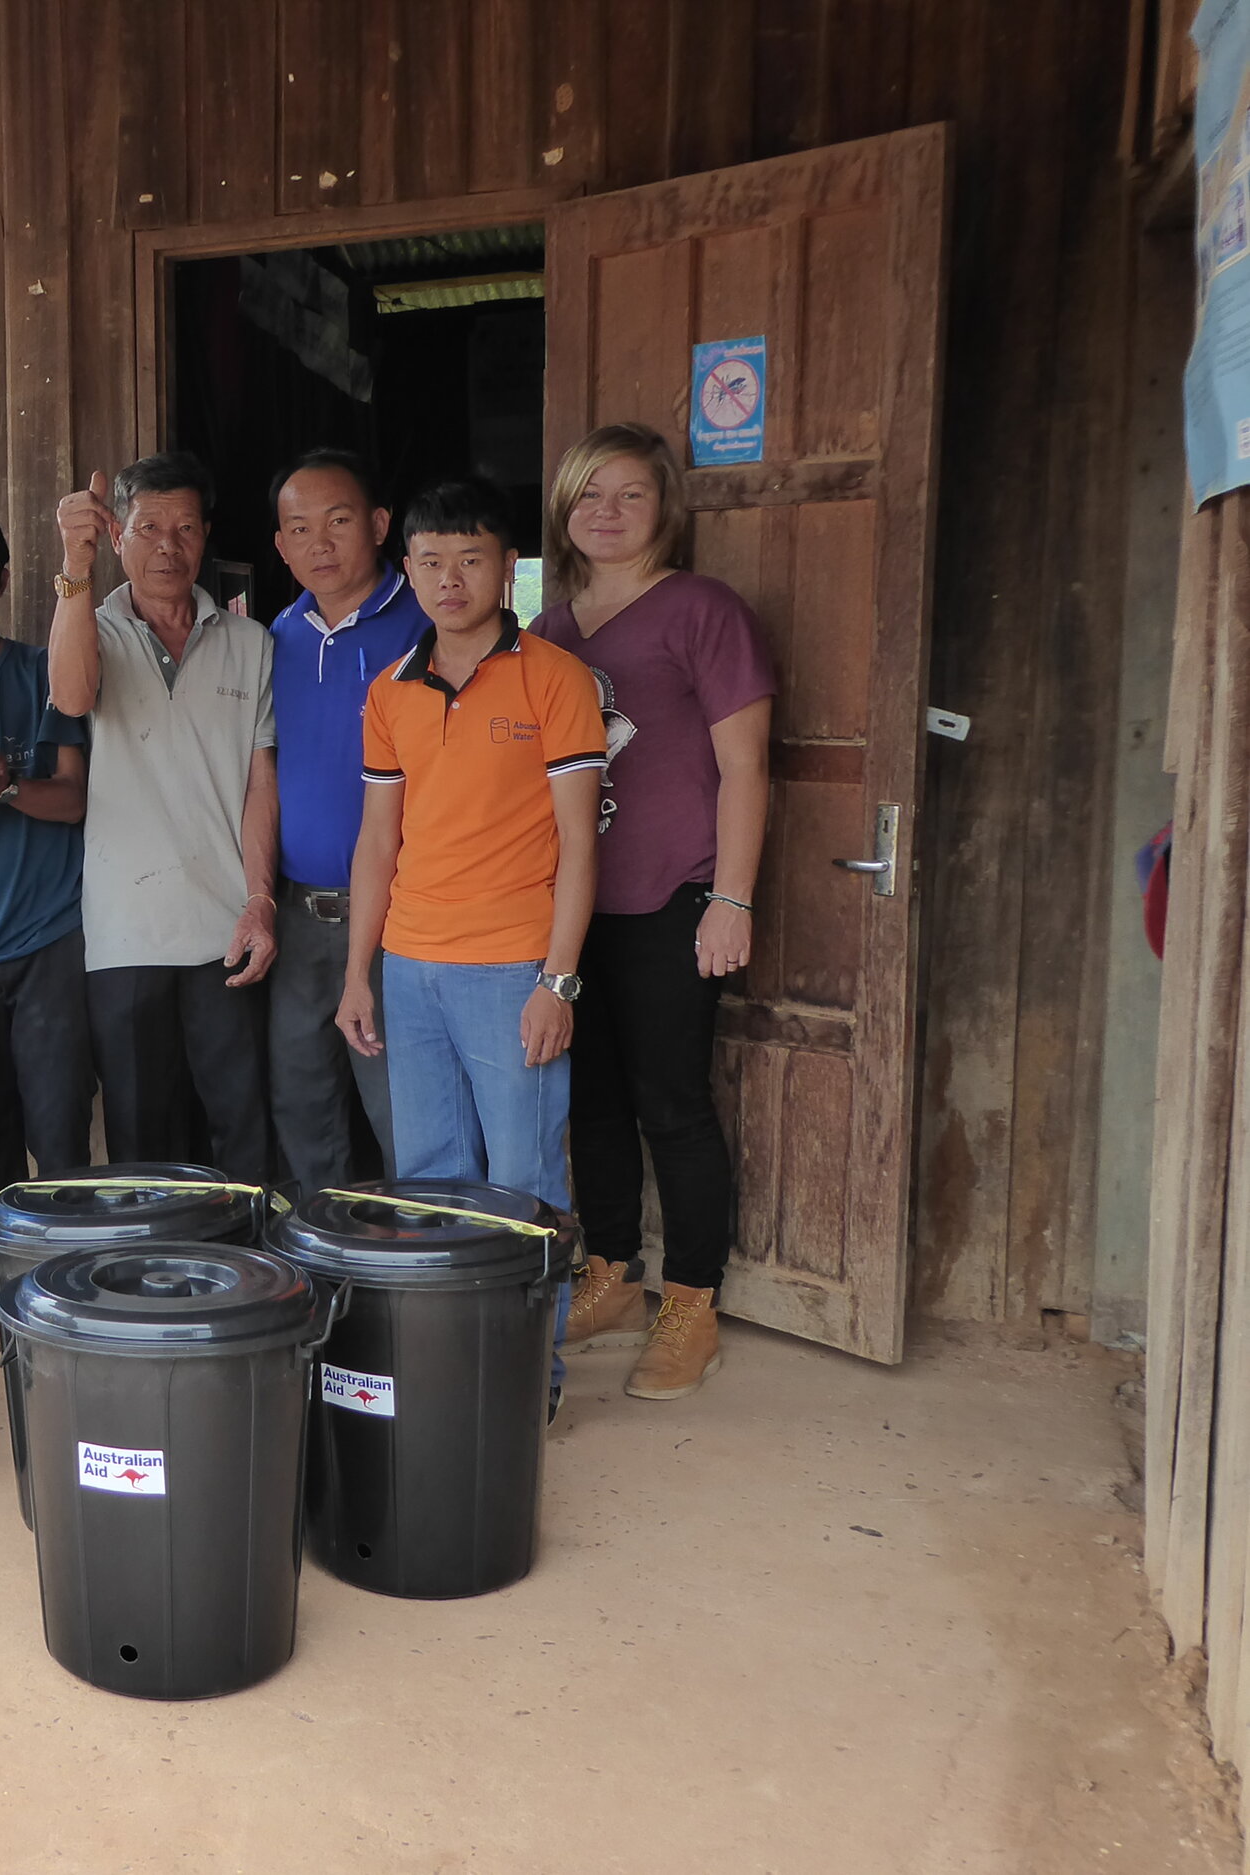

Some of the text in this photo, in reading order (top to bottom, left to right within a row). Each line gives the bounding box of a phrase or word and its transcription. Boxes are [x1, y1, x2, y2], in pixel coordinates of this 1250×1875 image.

[513, 732, 534, 740] Water
[324, 1367, 391, 1390] Australian
[324, 1381, 344, 1396] Aid
[83, 1447, 162, 1467] Australian
[84, 1463, 108, 1478] Aid
